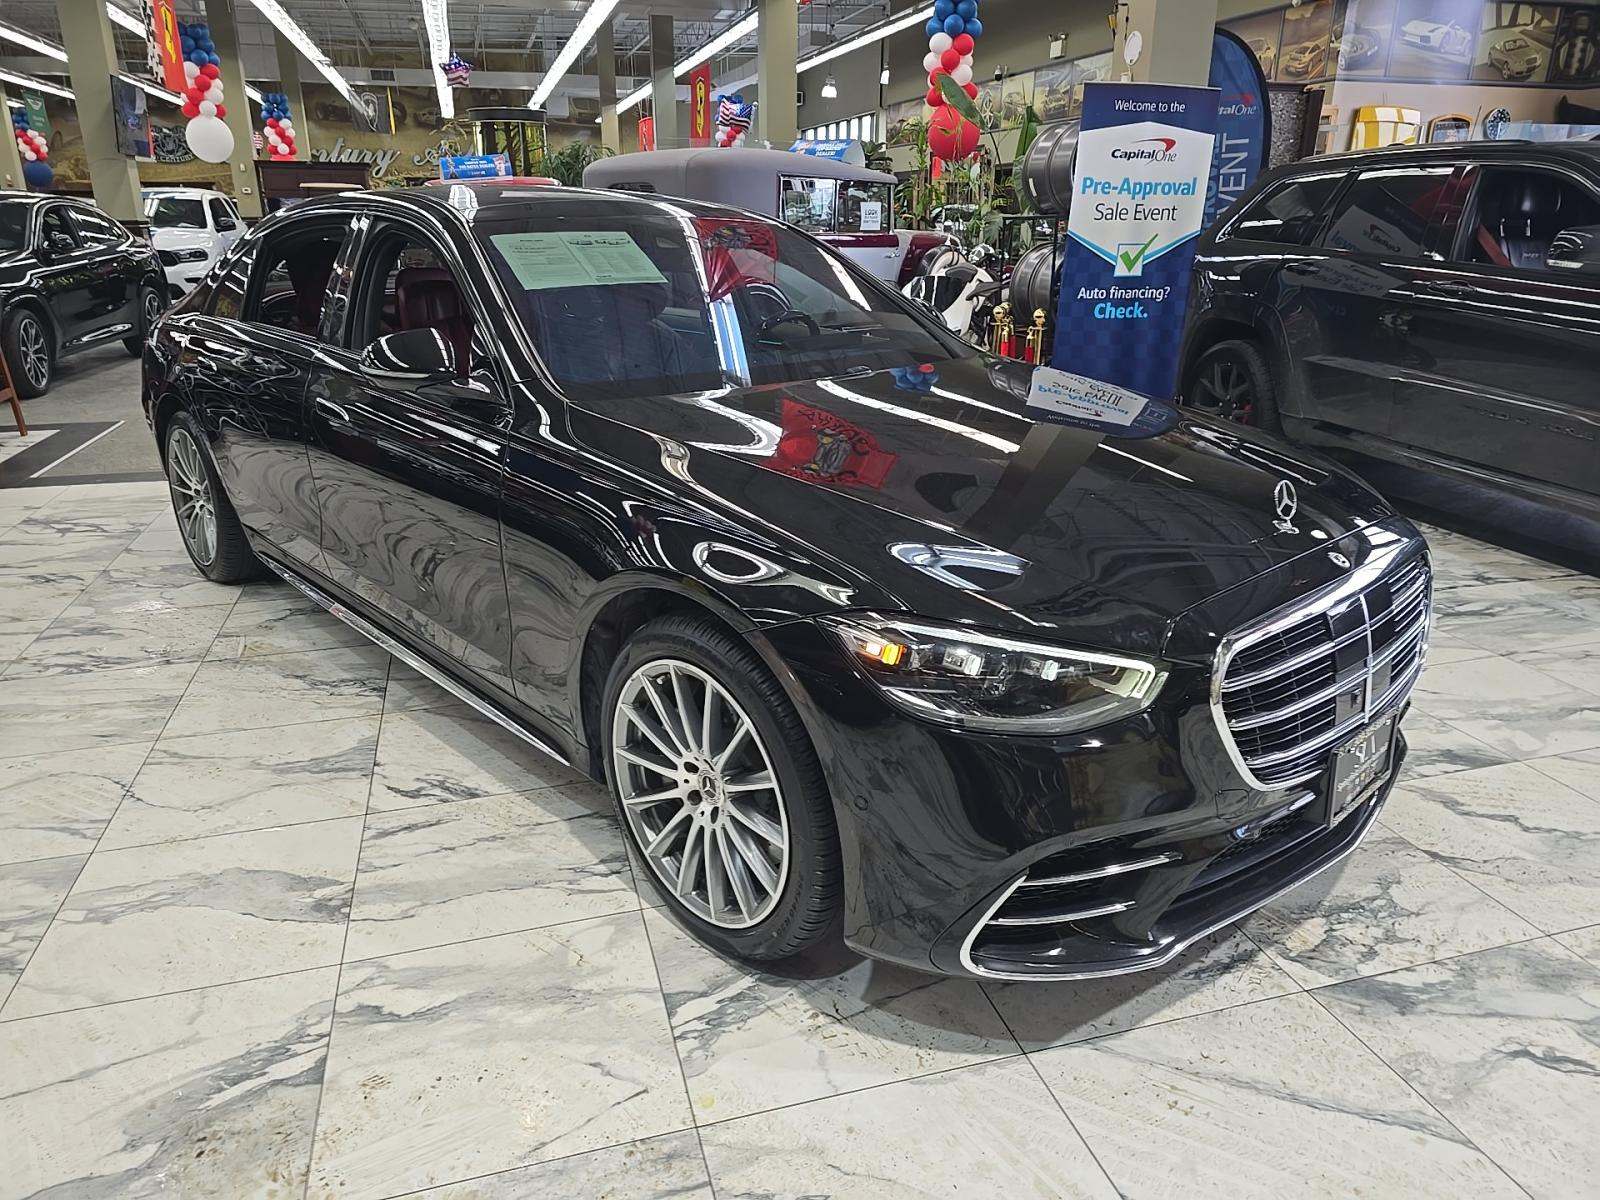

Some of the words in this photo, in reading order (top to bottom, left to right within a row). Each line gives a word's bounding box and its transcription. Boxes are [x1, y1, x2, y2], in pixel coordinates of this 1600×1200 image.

[1114, 100, 1156, 112] Welcome
[1158, 102, 1168, 112] to
[1170, 101, 1186, 112] the
[1218, 103, 1257, 116] talOne
[311, 138, 400, 178] ntury
[1217, 132, 1250, 218] VENT
[1081, 177, 1197, 200] Pre-Approval
[1094, 202, 1129, 221] Sale
[1133, 204, 1178, 221] Event
[1077, 287, 1107, 300] Auto
[1109, 286, 1171, 302] financing?
[1093, 302, 1148, 319] Check.
